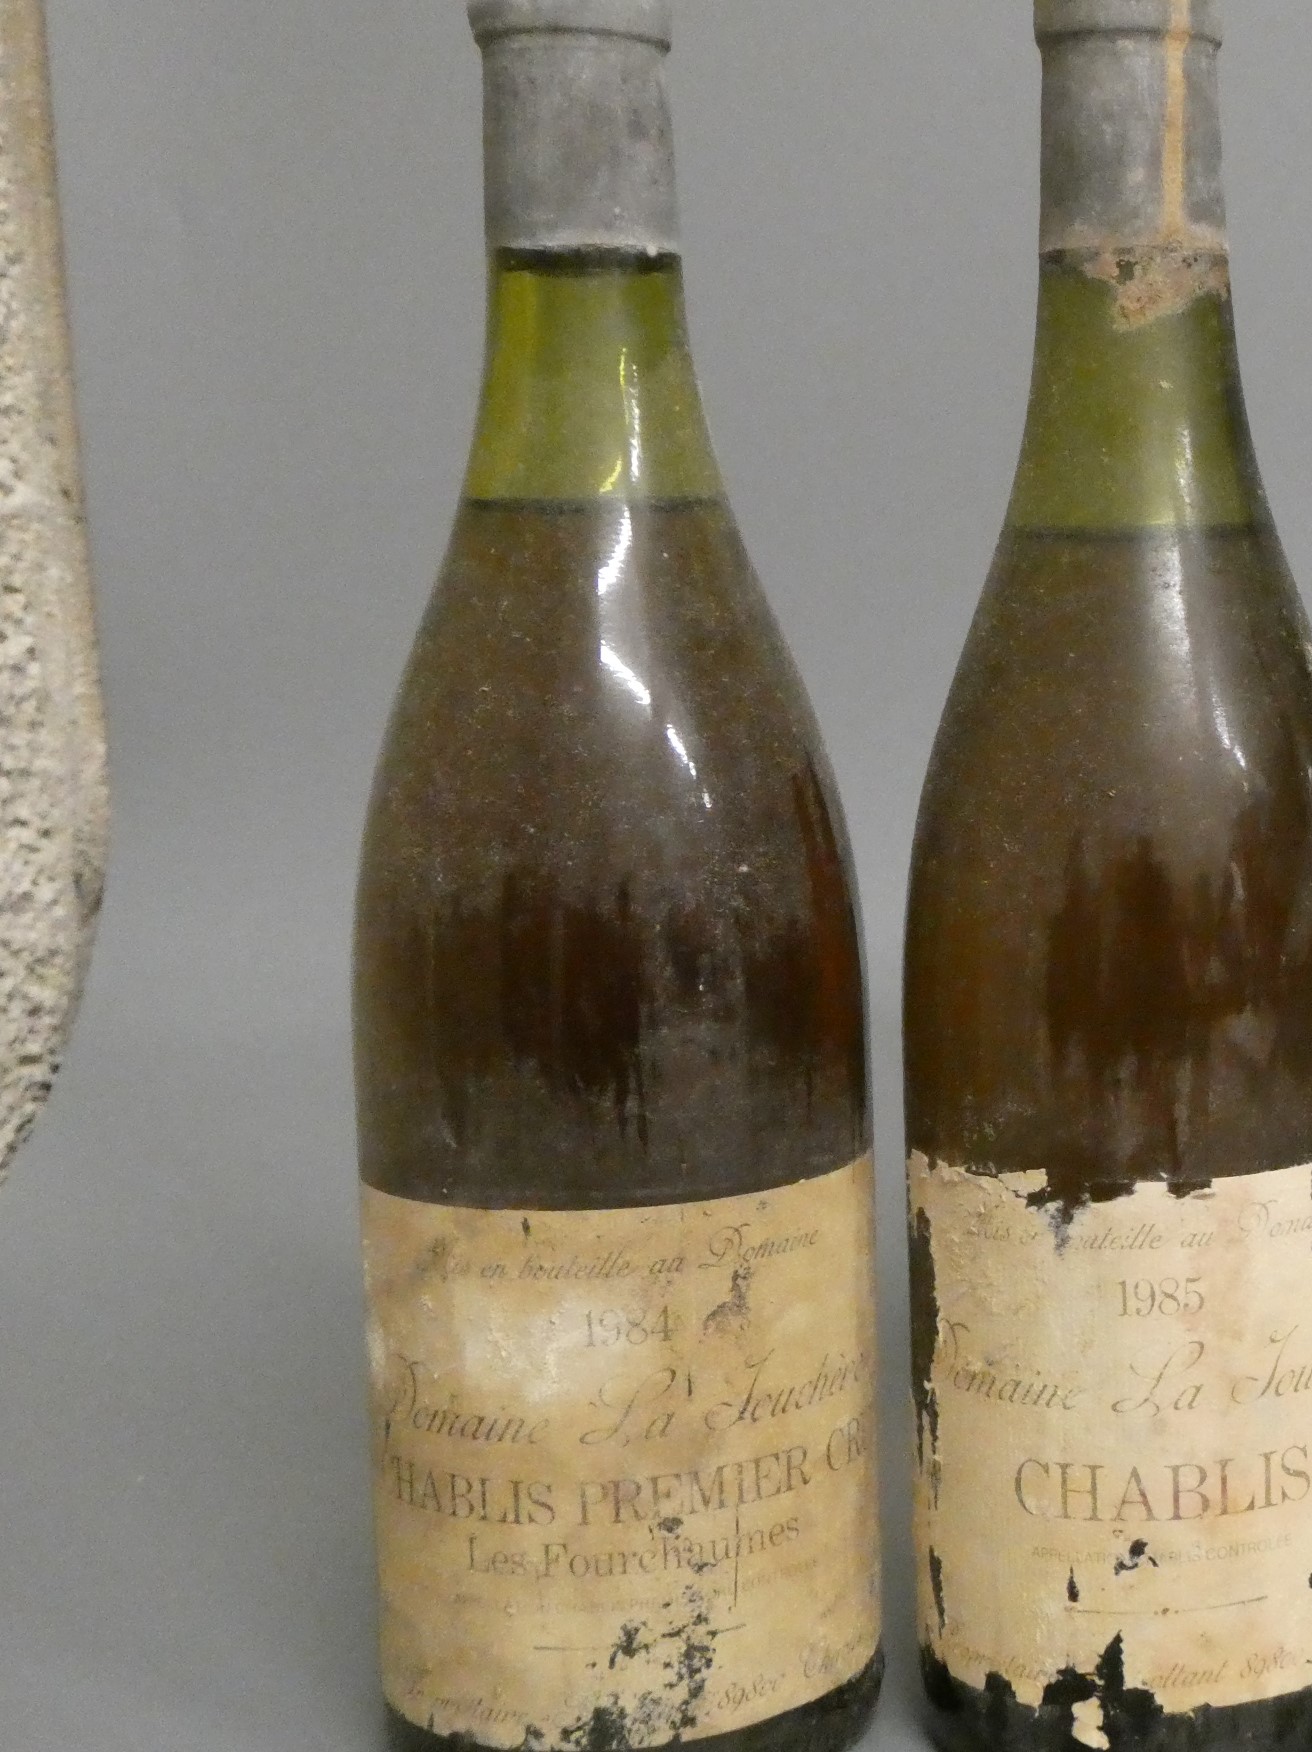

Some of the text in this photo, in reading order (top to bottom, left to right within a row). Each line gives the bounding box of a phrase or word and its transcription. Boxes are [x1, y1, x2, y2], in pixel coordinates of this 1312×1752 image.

[480, 1262, 507, 1279] en
[518, 1248, 631, 1280] bouteille
[699, 1221, 820, 1269] Domaine
[1181, 1230, 1216, 1250] au
[584, 1305, 681, 1347] 1984
[1117, 1277, 1206, 1317] 1985
[388, 1353, 550, 1447] Domaine
[579, 1368, 678, 1448] La
[1111, 1341, 1206, 1417] La
[388, 1415, 868, 1526] HABLIS PREMIER CR
[1015, 1446, 1311, 1522] CHABLIS
[467, 1534, 526, 1578] Les
[535, 1516, 801, 1580] Fourchaumes
[1031, 1545, 1132, 1565] APPELLATIO
